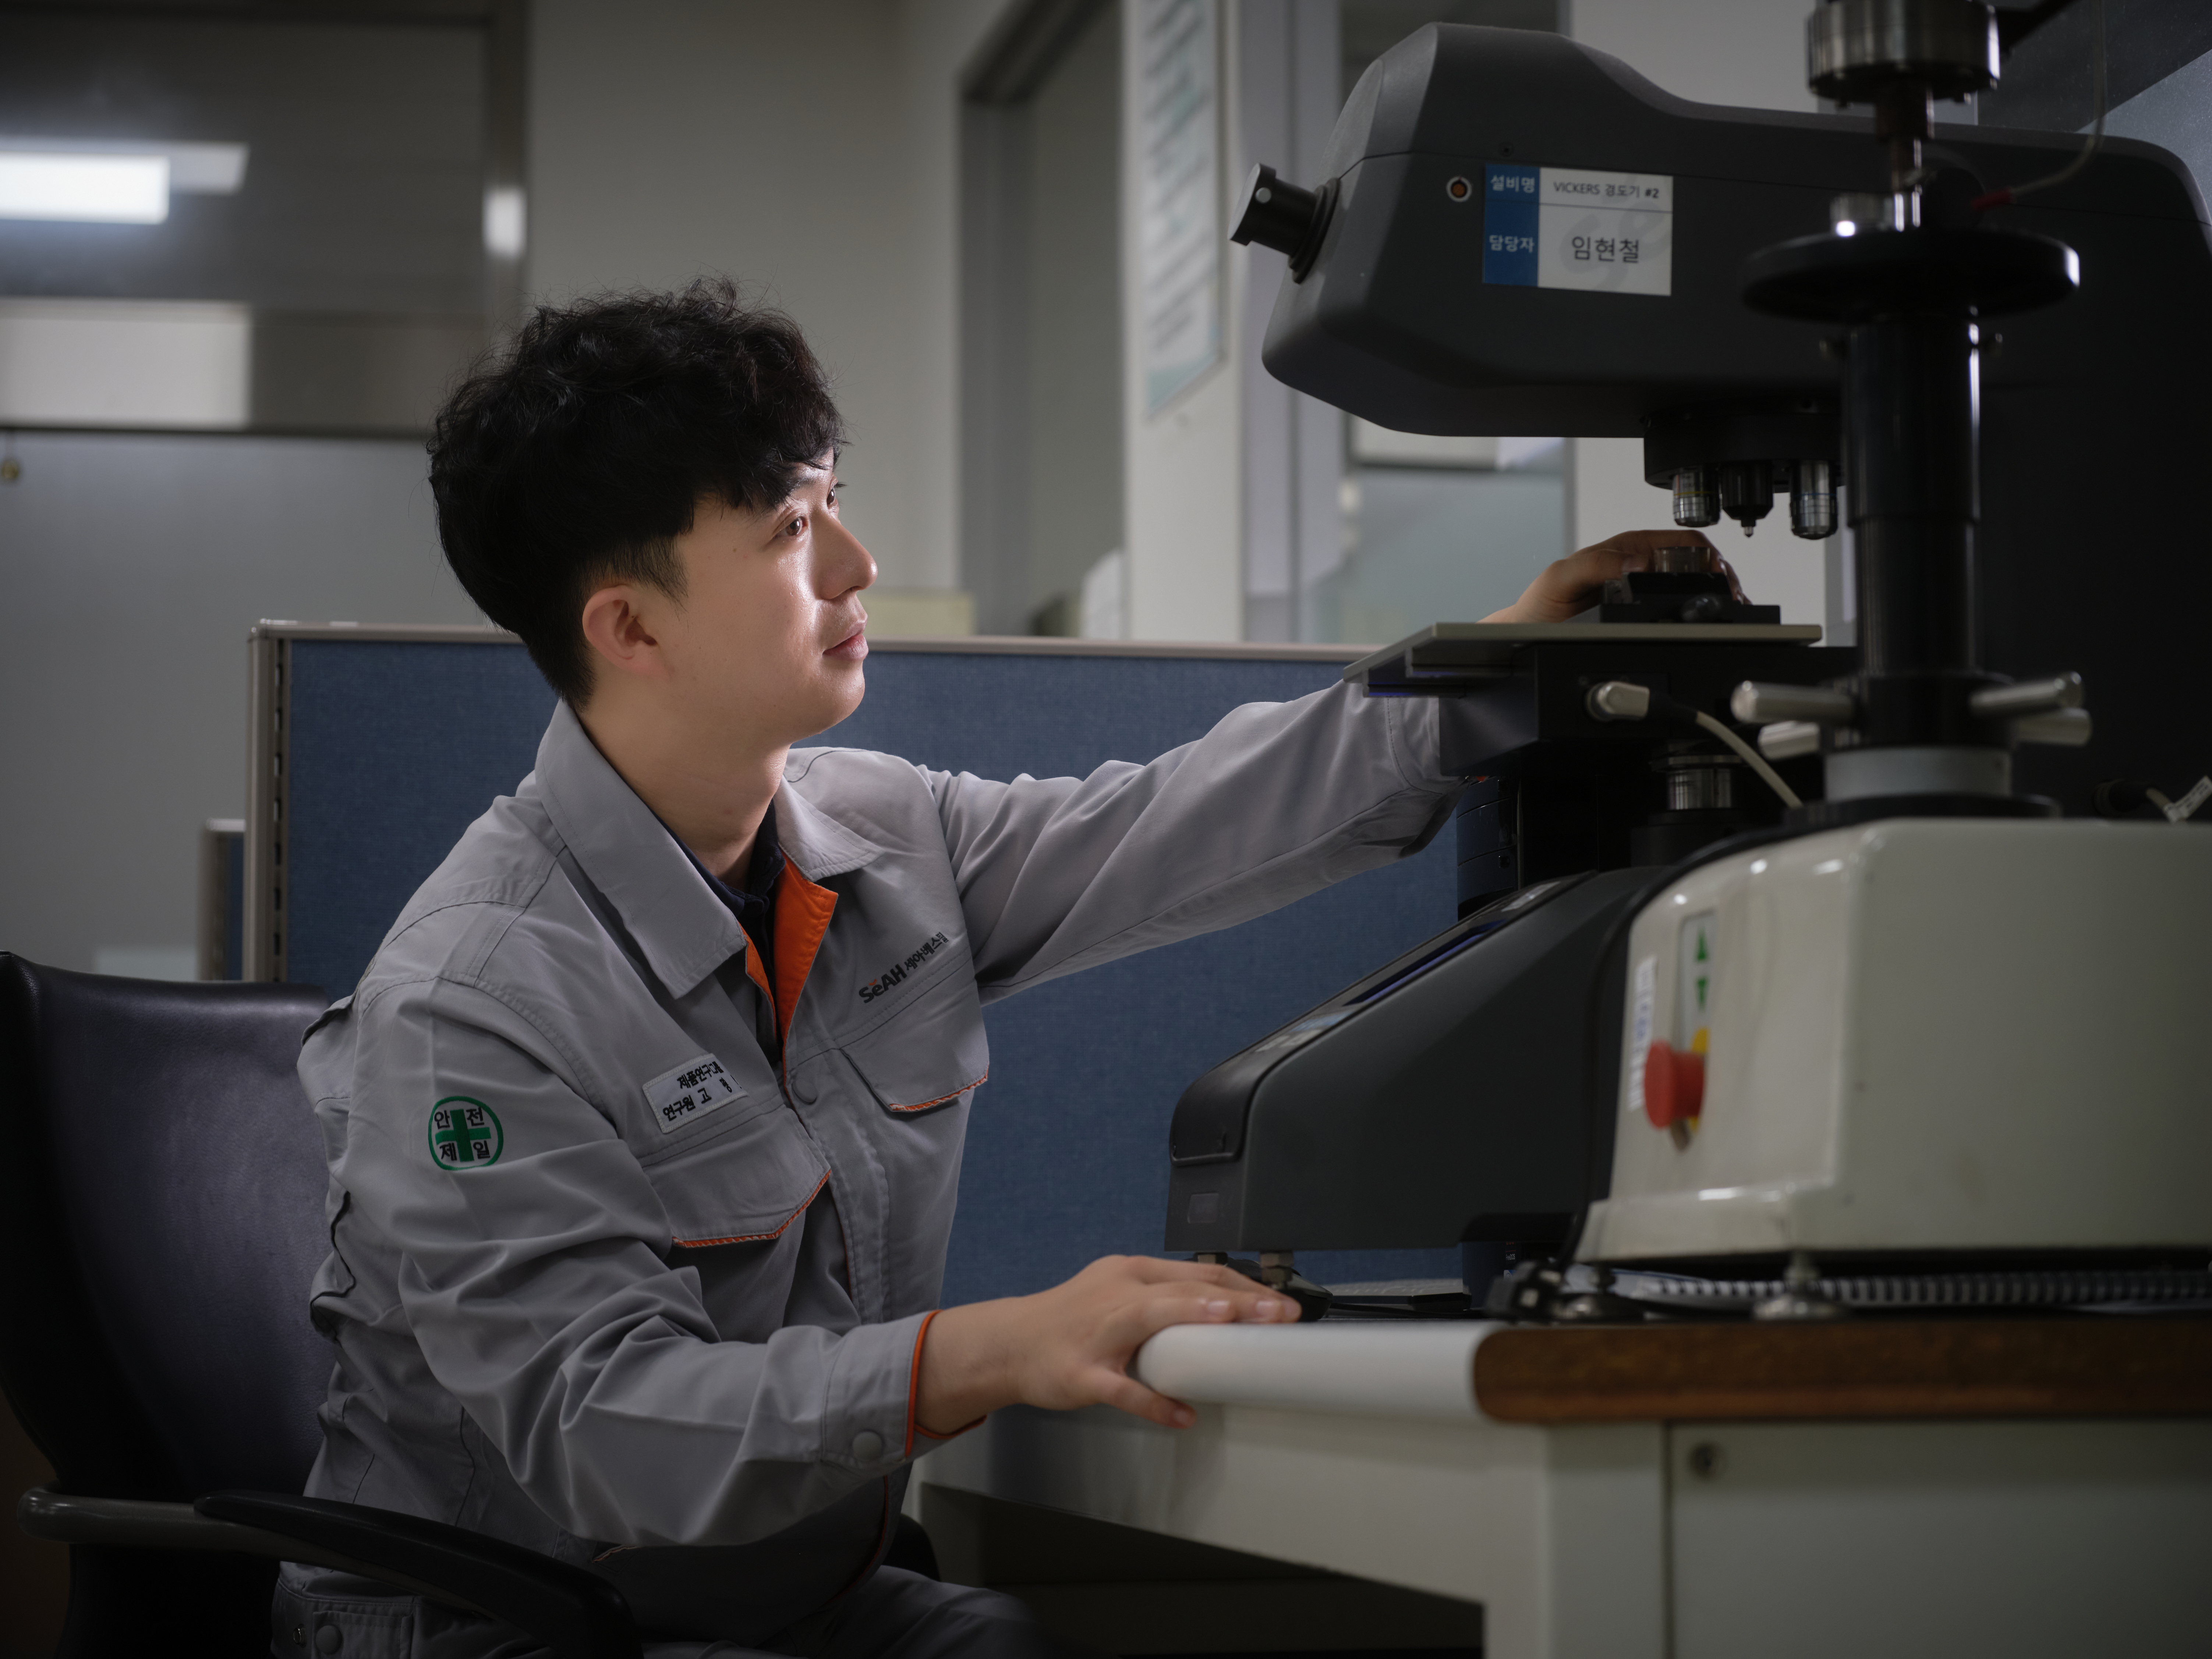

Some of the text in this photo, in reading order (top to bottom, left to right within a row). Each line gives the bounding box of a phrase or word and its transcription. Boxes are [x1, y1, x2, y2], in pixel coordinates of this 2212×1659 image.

[1490, 174, 1535, 193] 설비명
[1553, 182, 1659, 199] VICKERS 경도기 #2
[1489, 234, 1535, 254] 담당자
[1571, 236, 1639, 263] 임현철
[859, 964, 907, 1003] SeAH
[663, 1095, 696, 1121] 연구원
